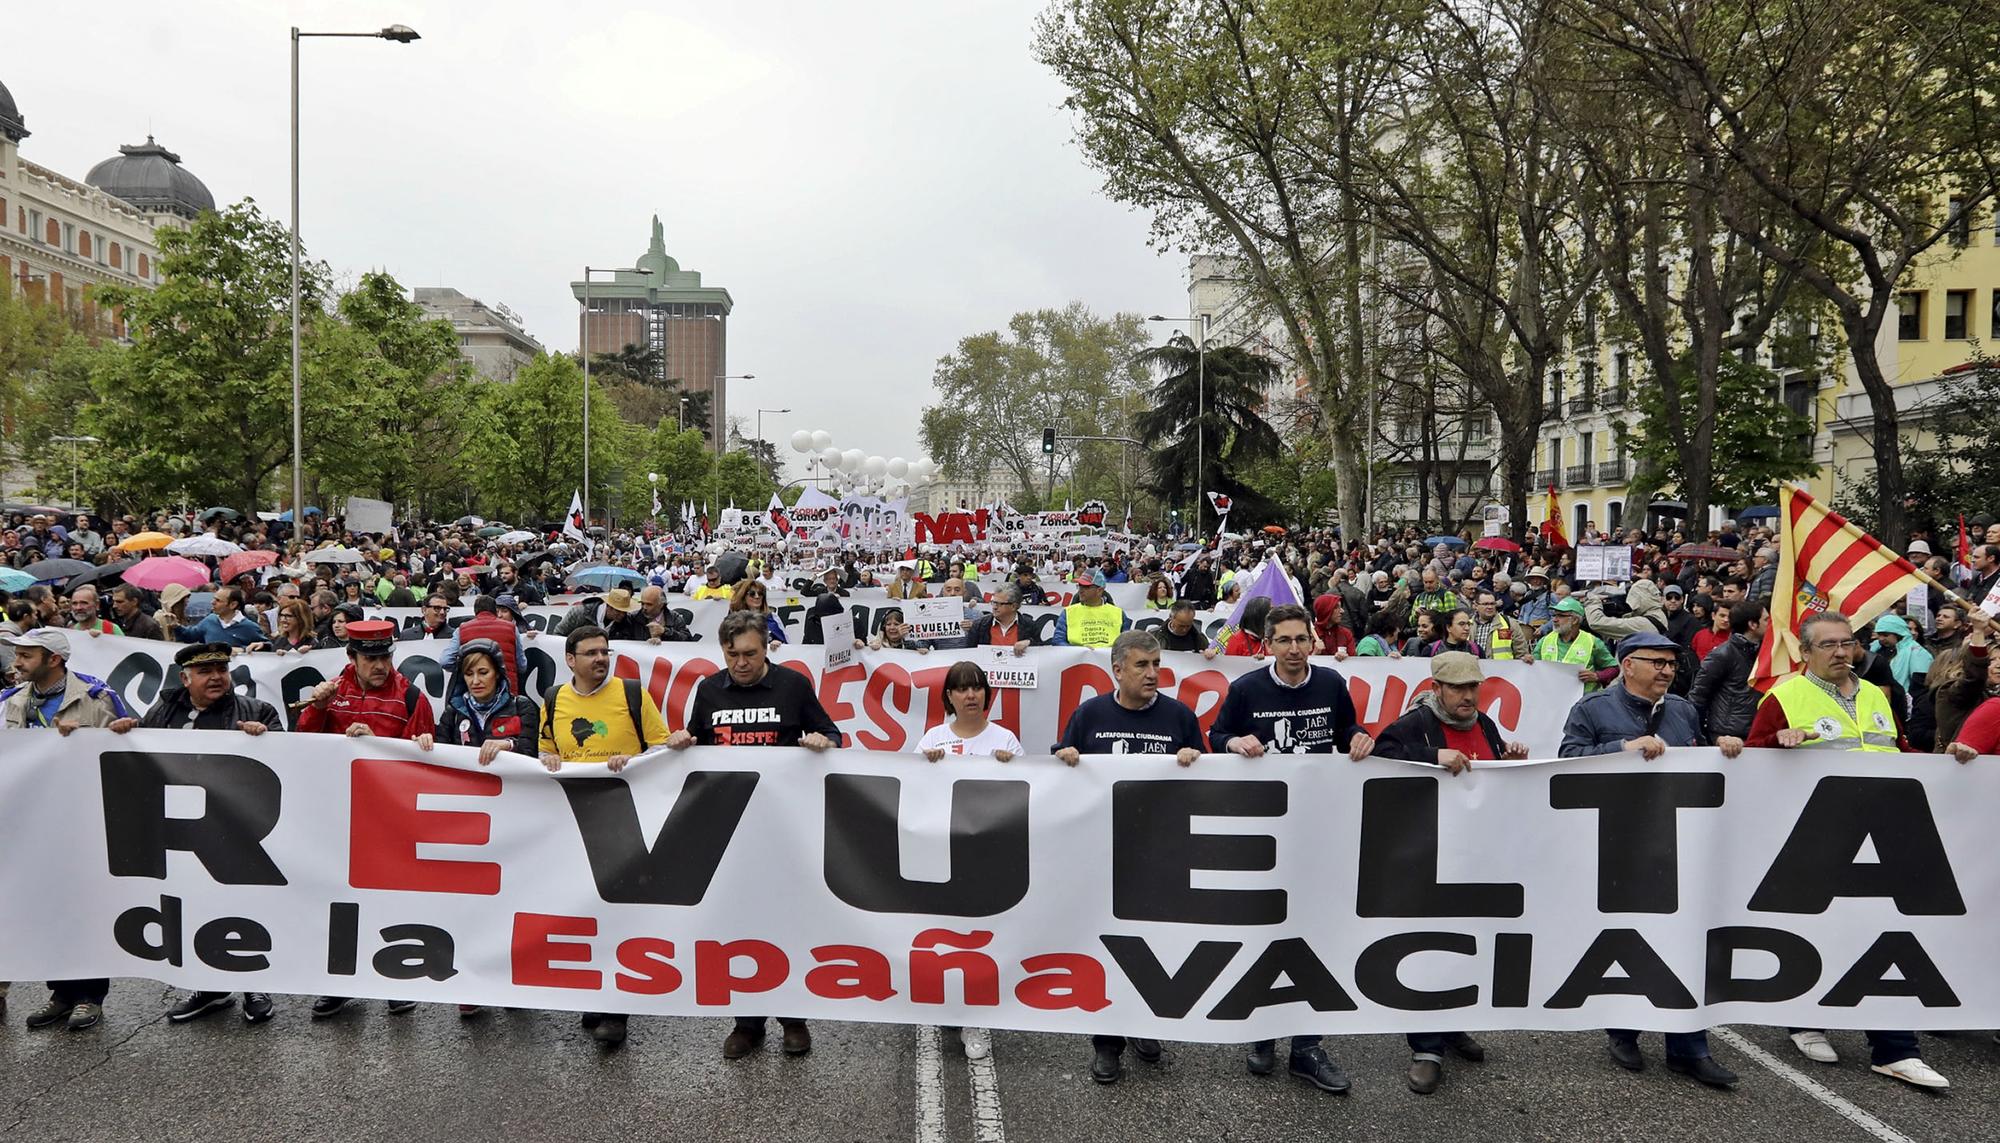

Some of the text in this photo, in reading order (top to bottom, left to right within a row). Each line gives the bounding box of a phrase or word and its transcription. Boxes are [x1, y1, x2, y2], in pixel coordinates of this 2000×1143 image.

[712, 707, 781, 726] TERUEL
[1136, 733, 1172, 742] CIUDADANA
[99, 750, 1968, 926] REVUELTA
[113, 895, 271, 973] de
[327, 902, 459, 981] la
